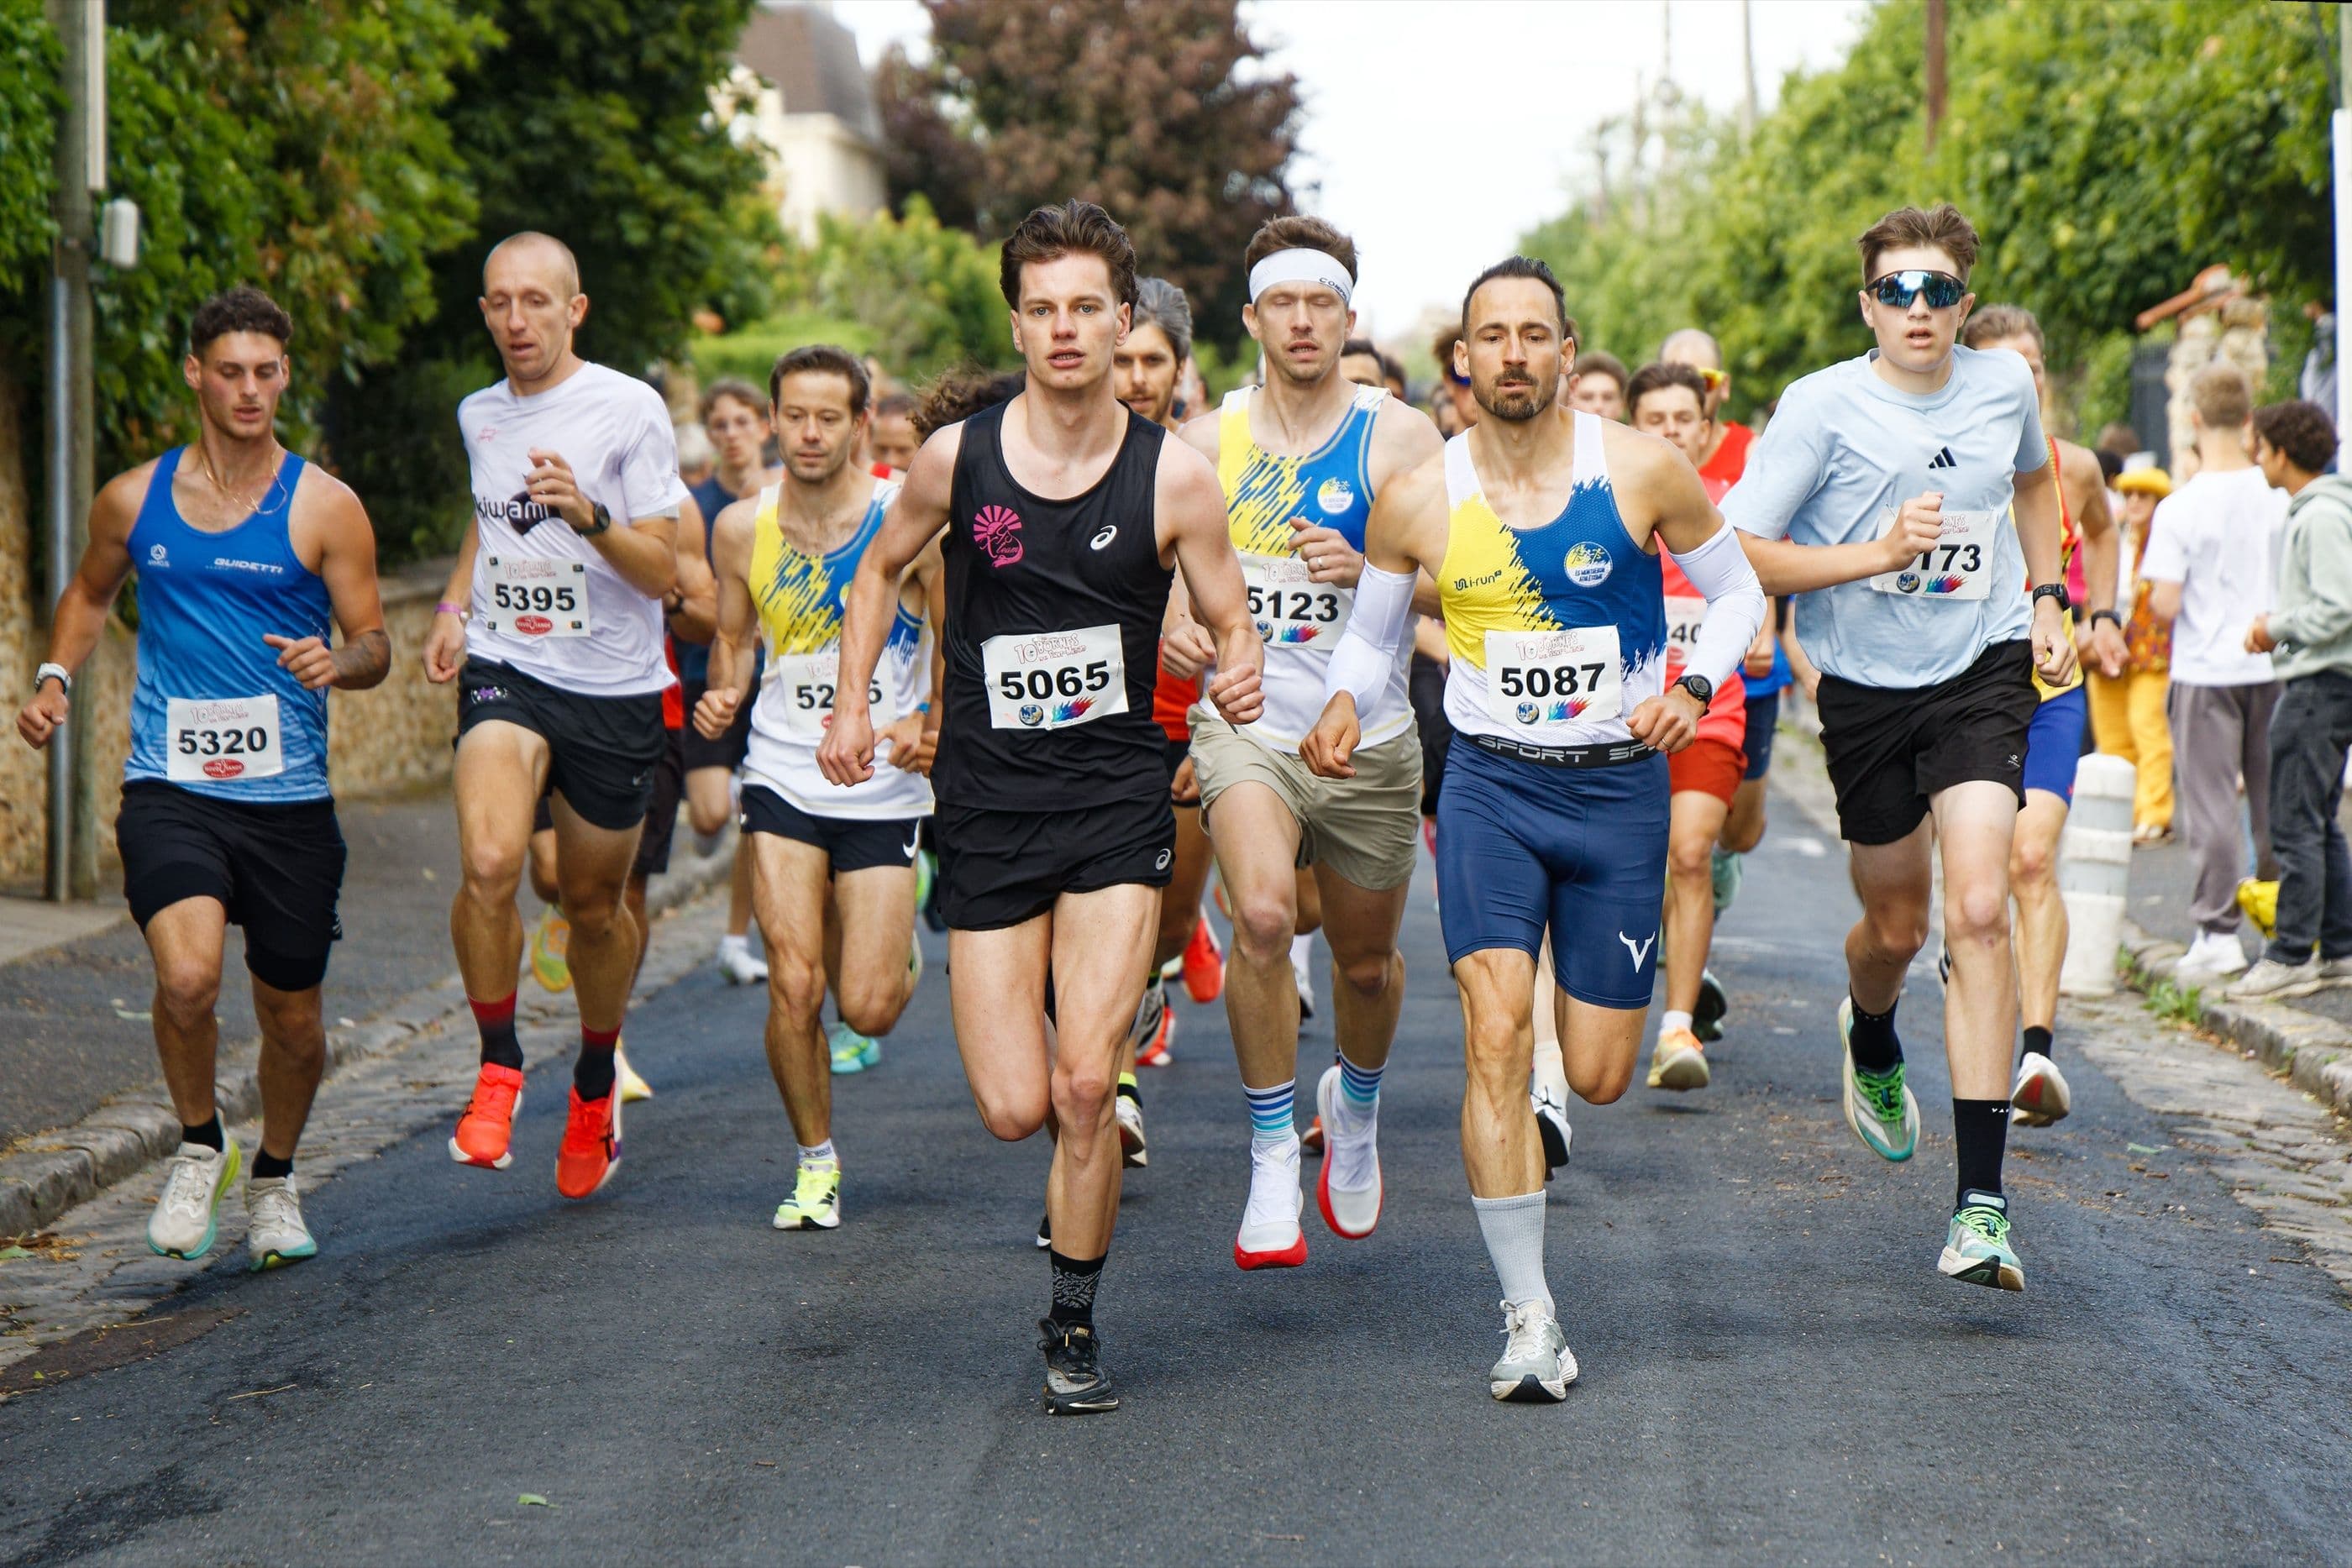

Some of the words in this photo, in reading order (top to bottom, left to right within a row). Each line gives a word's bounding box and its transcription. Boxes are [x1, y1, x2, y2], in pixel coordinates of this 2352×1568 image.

[214, 557, 284, 574] GUIDETTI
[1921, 543, 1982, 573] 173
[495, 583, 575, 611] 5395
[1247, 585, 1339, 622] 5123
[1013, 643, 1038, 664] 10
[795, 679, 883, 710] 526
[1000, 660, 1110, 700] 5065
[1500, 662, 1606, 698] 5087
[178, 726, 267, 755] 5320
[1478, 734, 1589, 763] SPORT
[1609, 742, 1656, 761] SP
